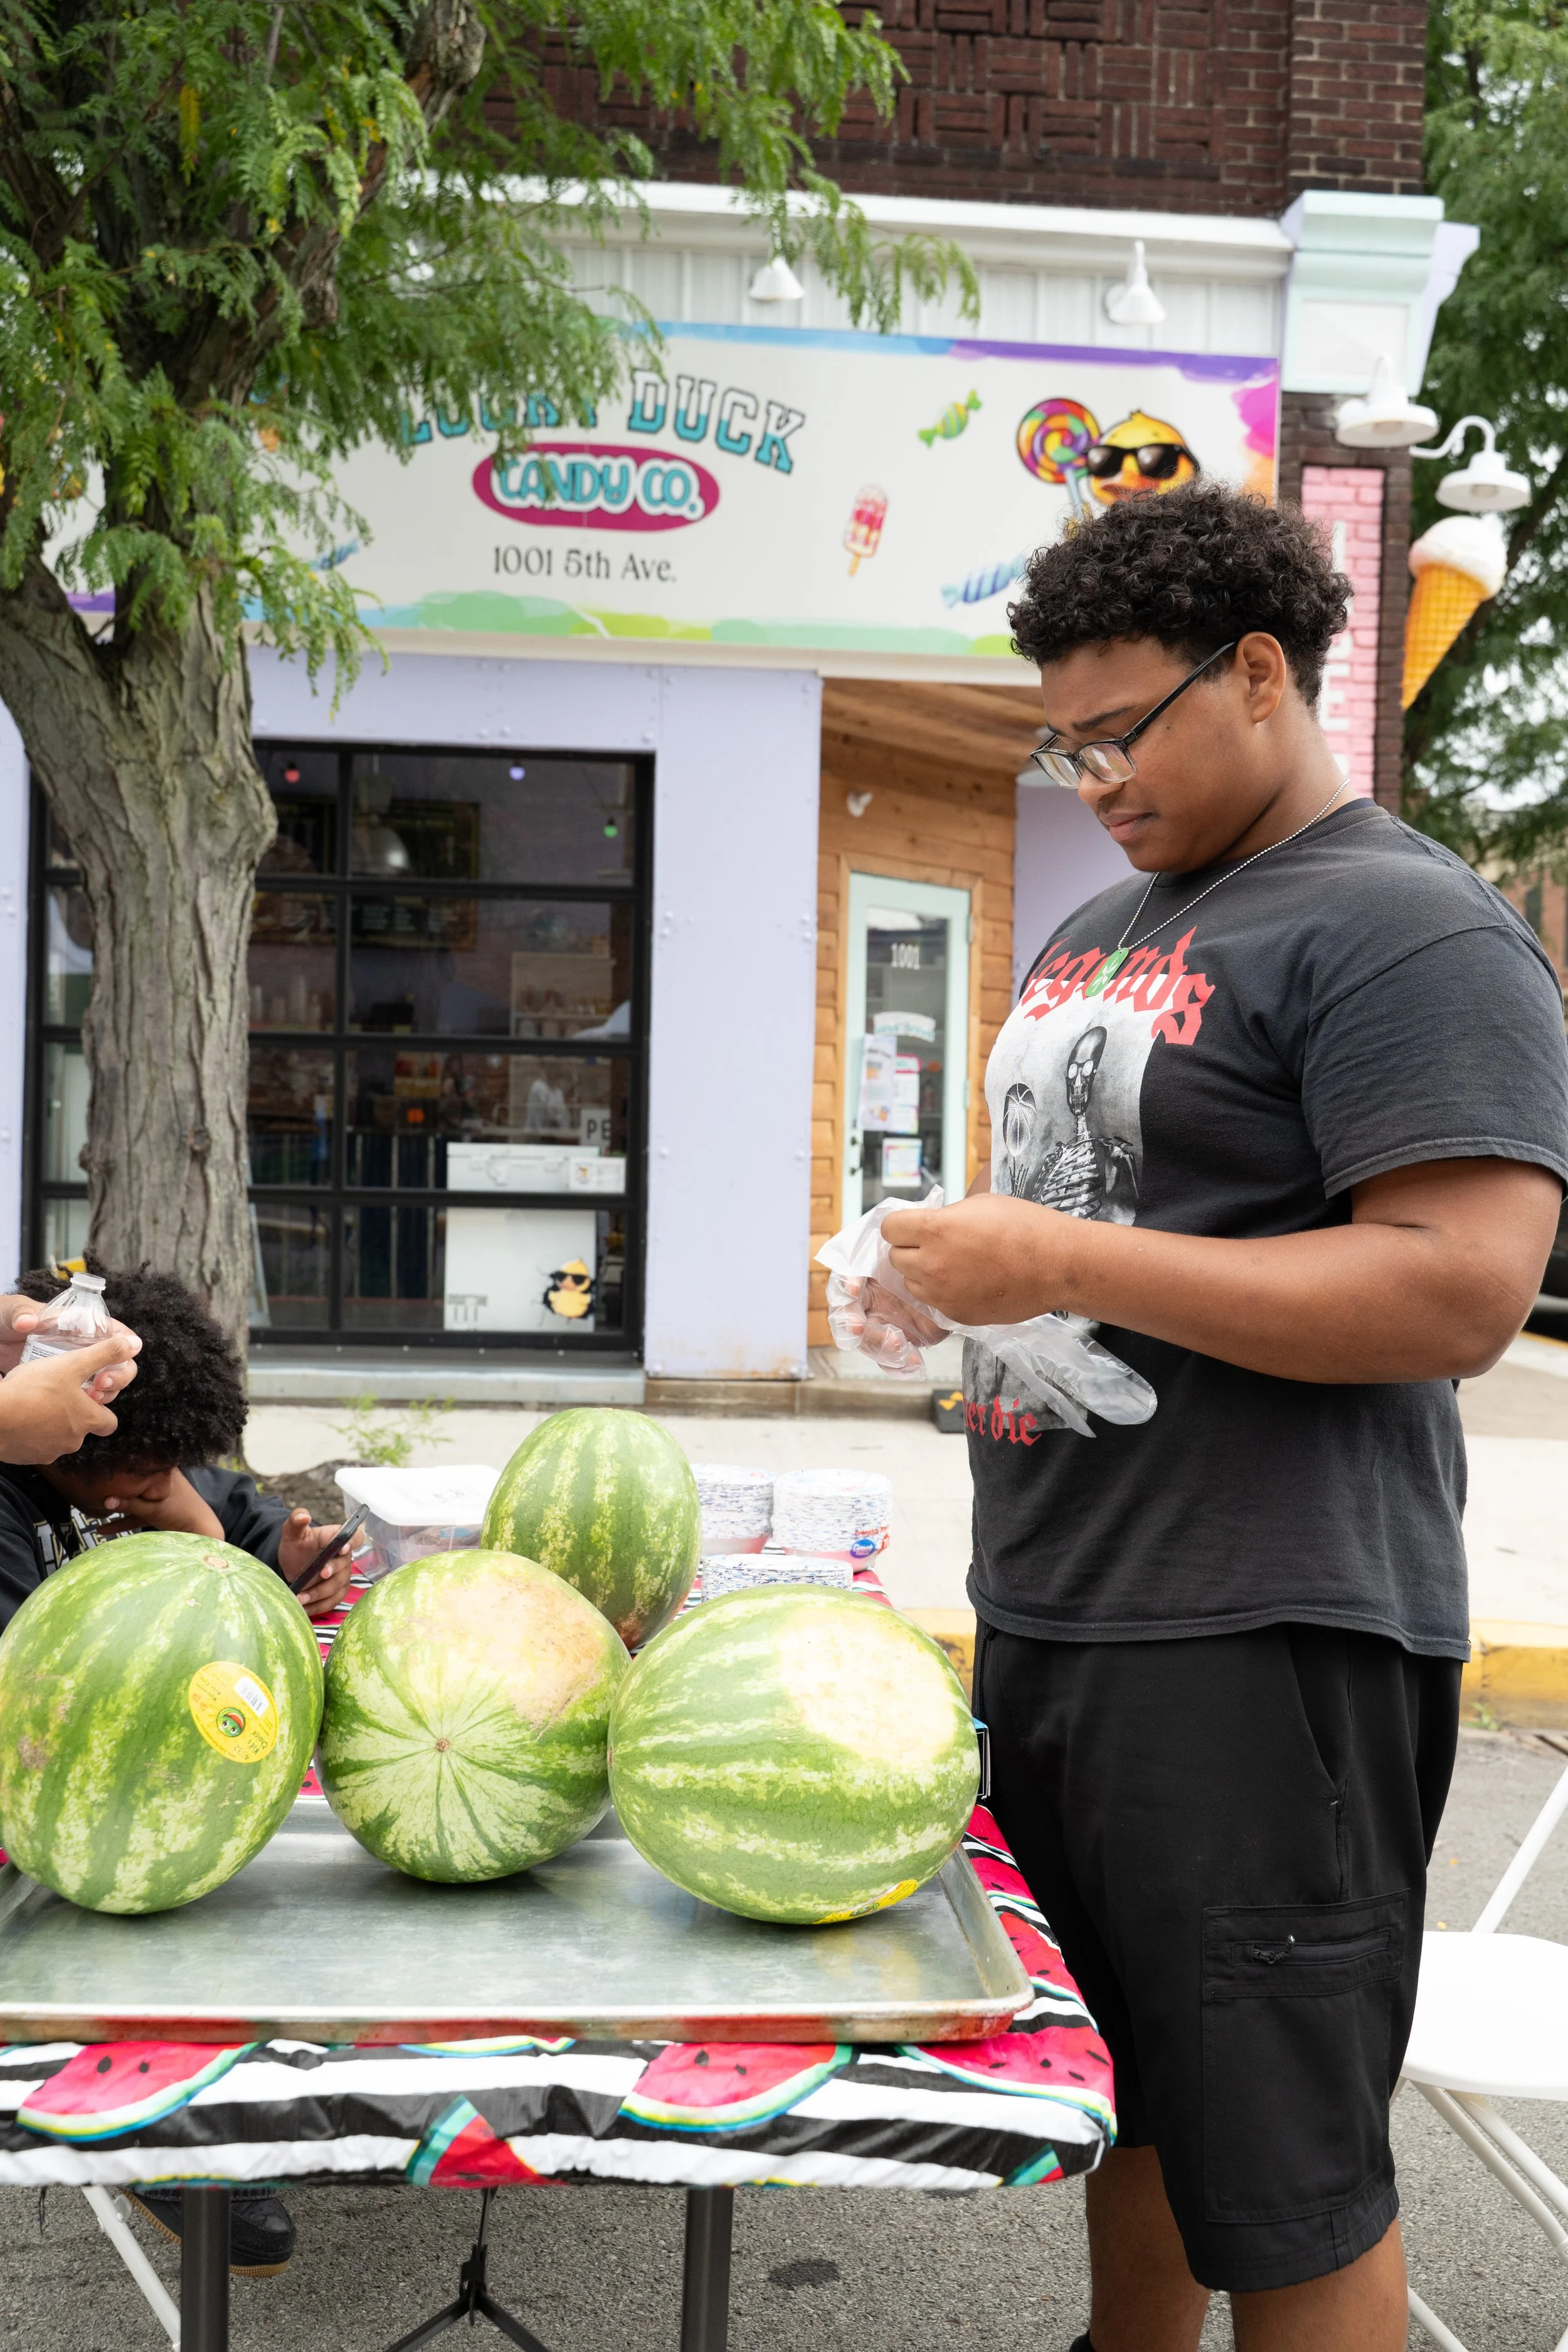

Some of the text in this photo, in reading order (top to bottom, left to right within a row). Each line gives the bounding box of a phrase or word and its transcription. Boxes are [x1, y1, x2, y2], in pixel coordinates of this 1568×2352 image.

[399, 366, 806, 475] LUCK DUCK
[500, 460, 697, 513] CANDY CO.
[493, 544, 677, 584] 1001 5th Ave.
[891, 942, 920, 970] 1001
[252, 1730, 268, 1749] Choice
